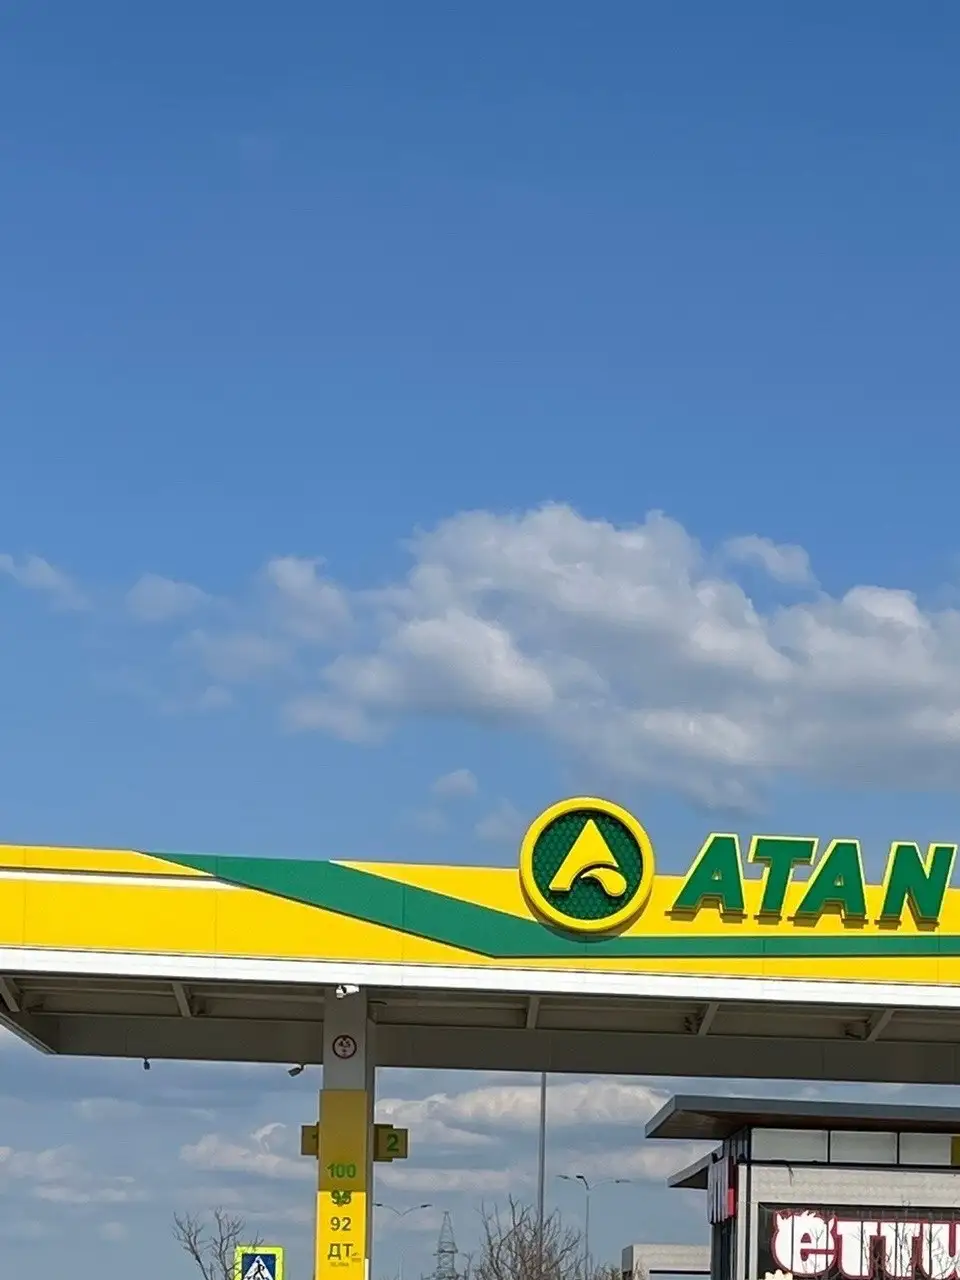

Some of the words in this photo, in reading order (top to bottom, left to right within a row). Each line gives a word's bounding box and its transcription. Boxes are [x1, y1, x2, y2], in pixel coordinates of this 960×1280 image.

[670, 832, 958, 925] ATAN
[387, 1134, 399, 1151] 2
[327, 1163, 357, 1179] 100
[330, 1216, 352, 1232] 92
[327, 1243, 354, 1260] ДТ
